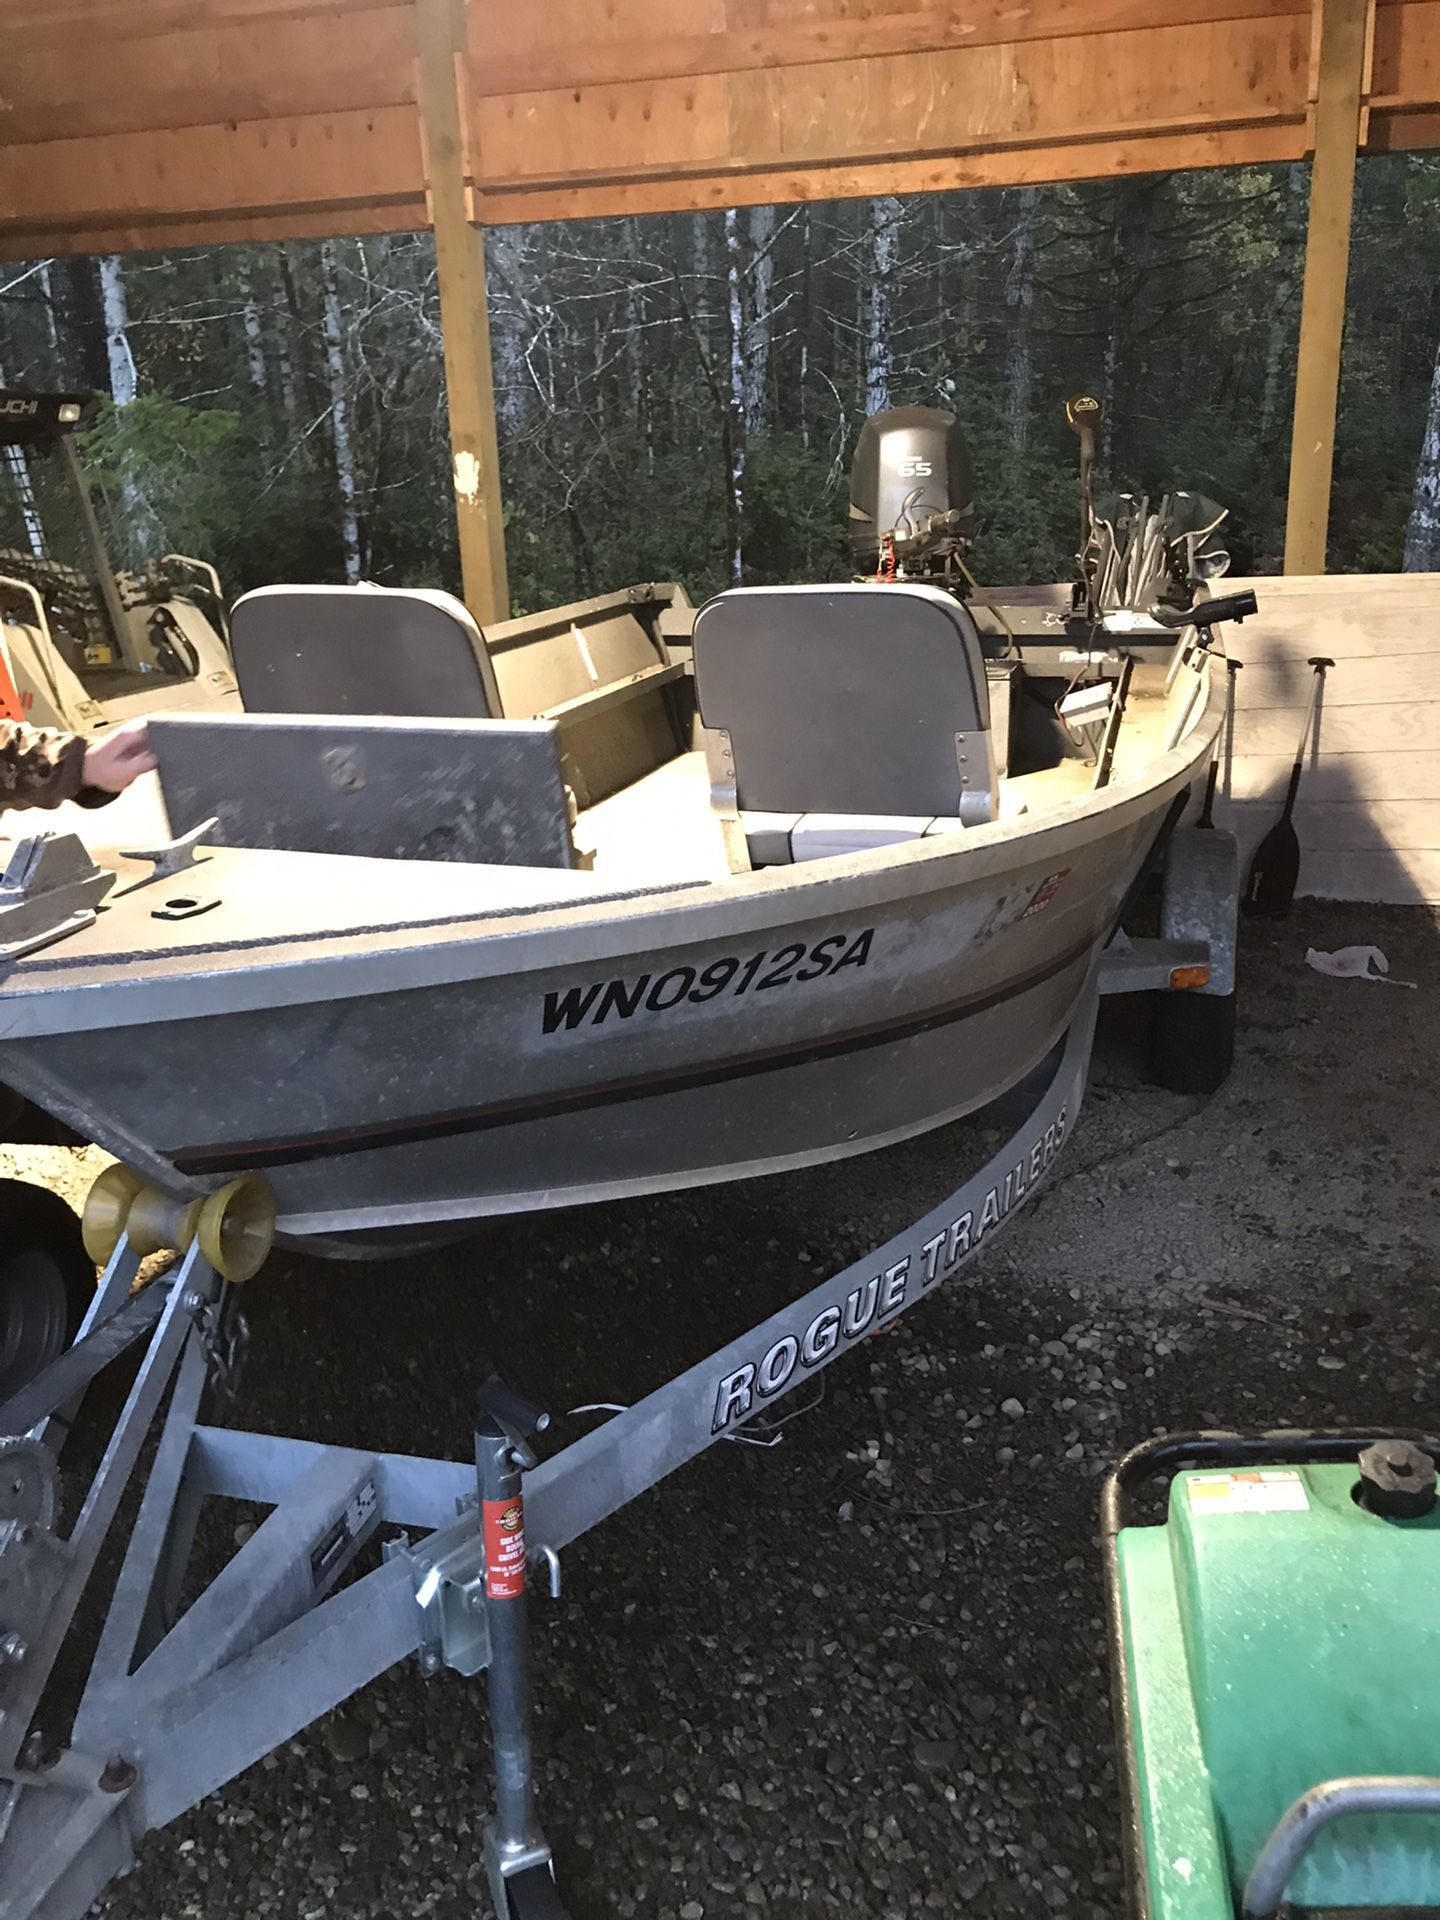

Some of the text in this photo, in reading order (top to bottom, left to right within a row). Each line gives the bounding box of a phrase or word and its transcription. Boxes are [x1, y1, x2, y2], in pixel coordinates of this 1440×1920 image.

[898, 462, 932, 477] 65
[711, 1104, 1067, 1436] ROGUE TRAILERS
